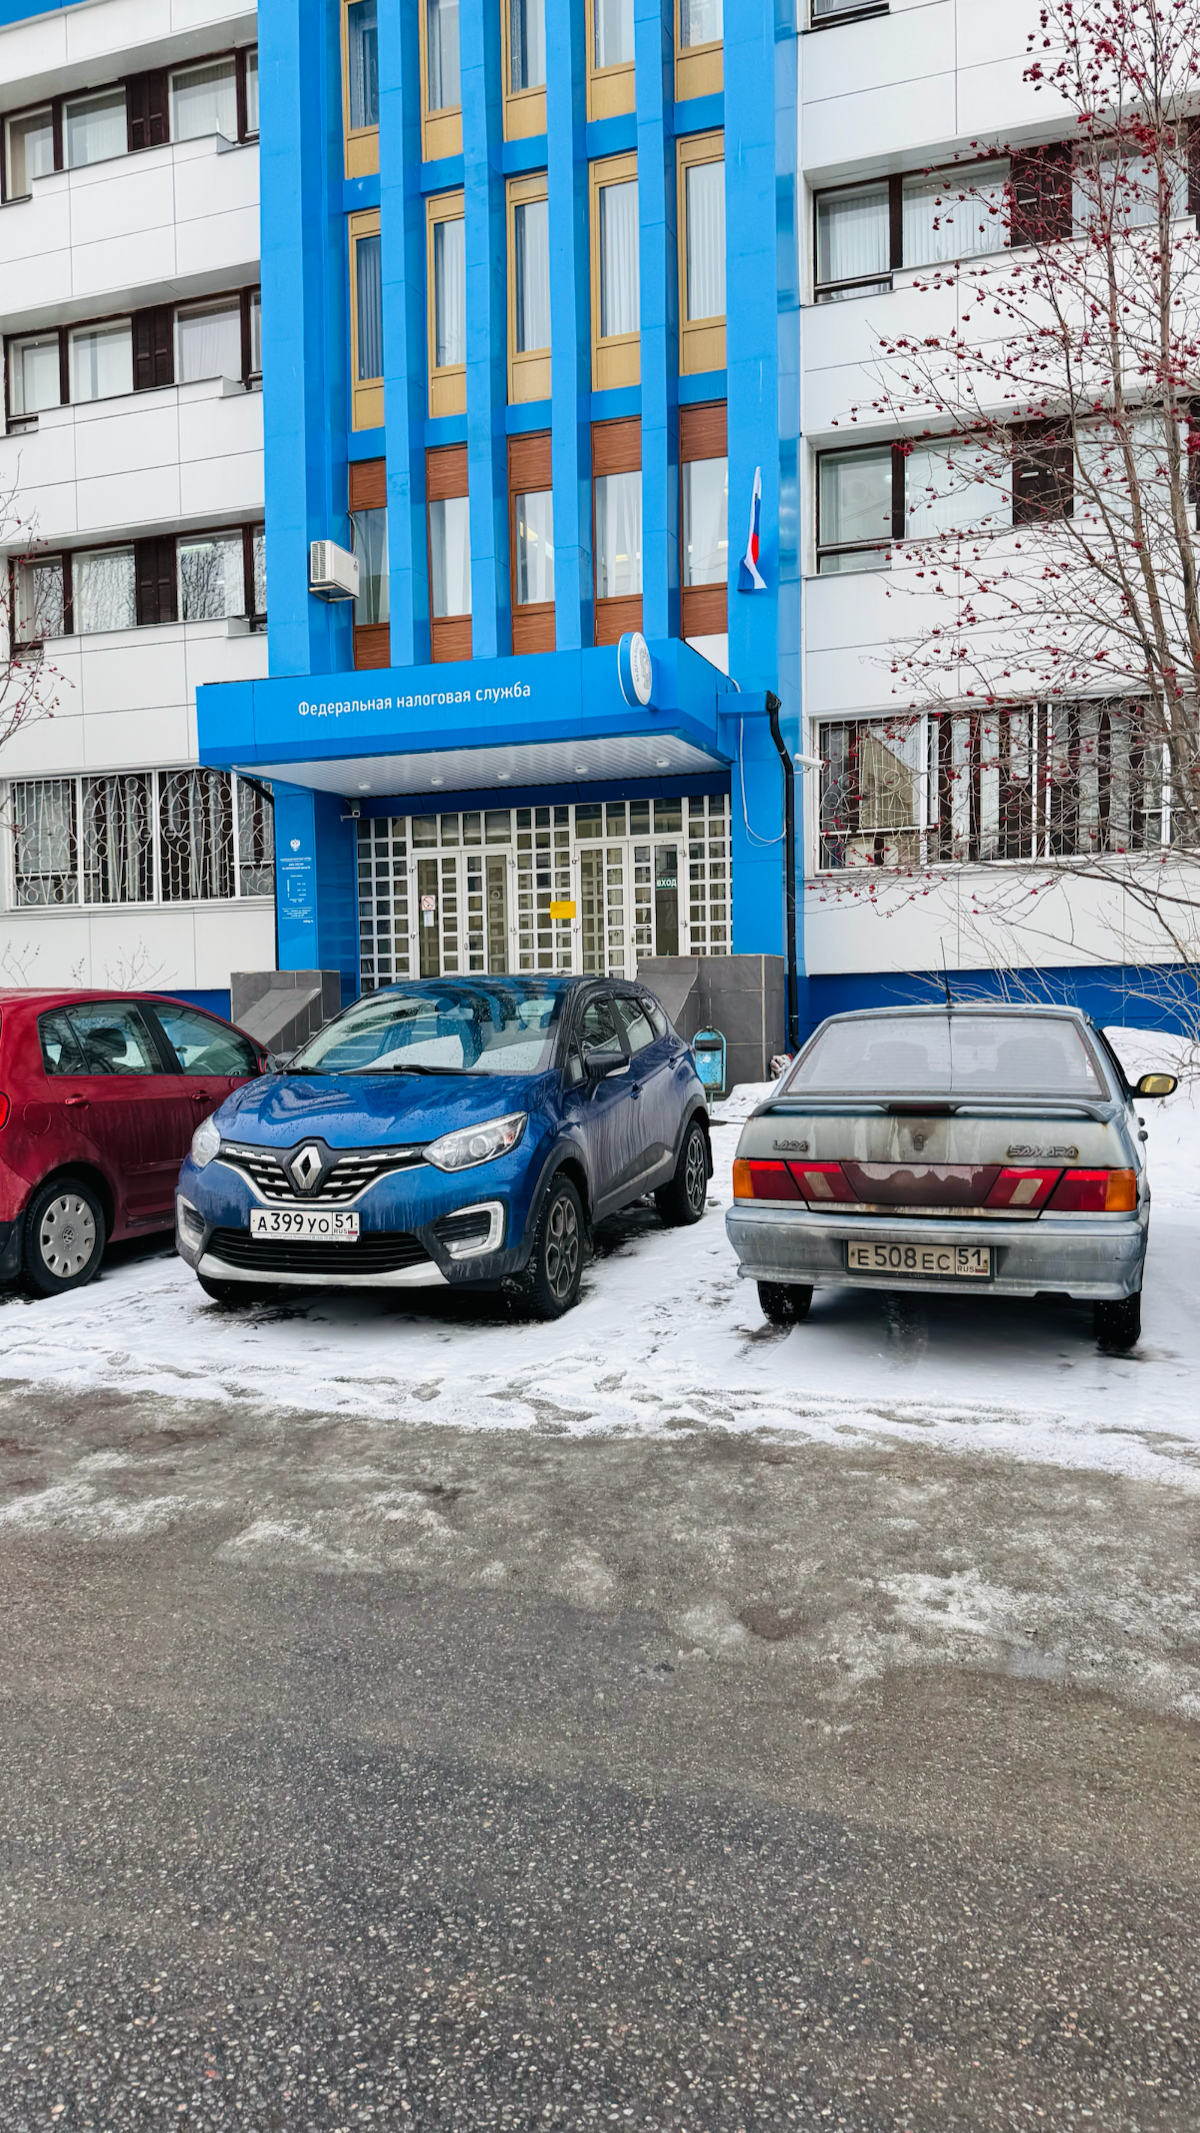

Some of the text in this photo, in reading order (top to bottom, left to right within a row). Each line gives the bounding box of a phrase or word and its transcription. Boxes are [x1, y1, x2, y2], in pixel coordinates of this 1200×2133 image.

[298, 681, 531, 718] Федеральная налоговая служба
[656, 878, 677, 888] ВХОД
[772, 1139, 809, 1152] LADA
[1007, 1145, 1079, 1159] SAMARA
[335, 1214, 354, 1229] 51
[333, 1227, 348, 1235] RUS
[958, 1248, 982, 1266] 51
[957, 1265, 975, 1273] RUS
